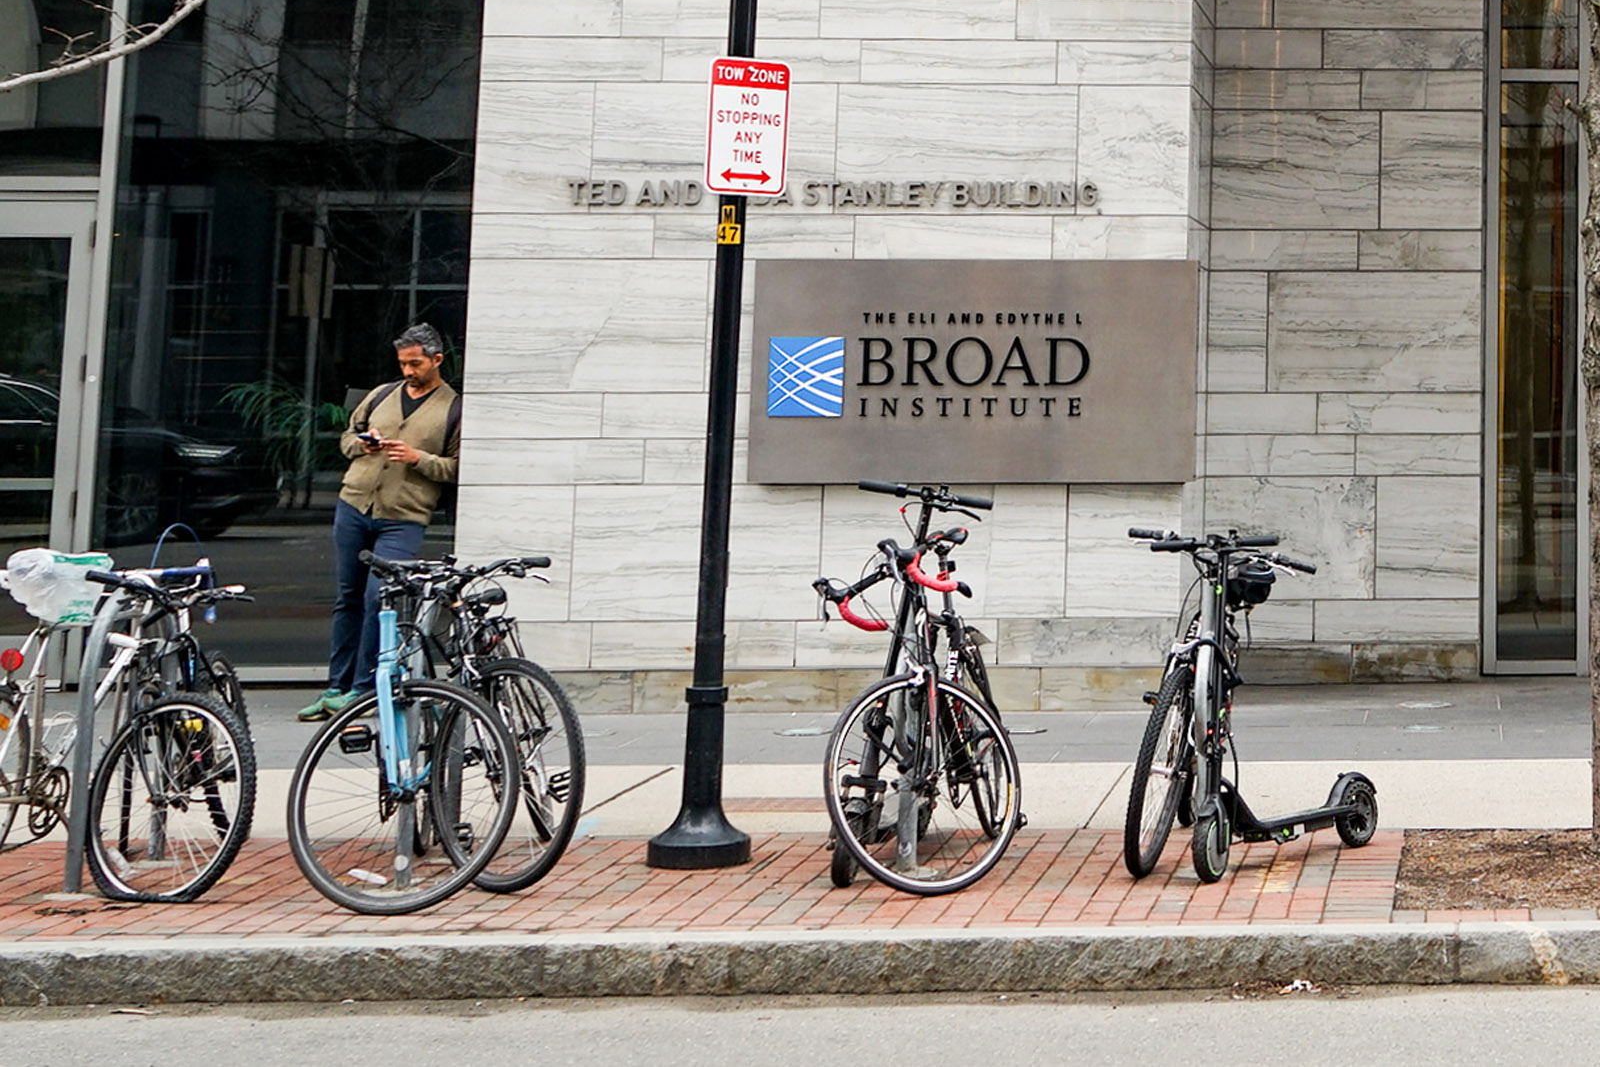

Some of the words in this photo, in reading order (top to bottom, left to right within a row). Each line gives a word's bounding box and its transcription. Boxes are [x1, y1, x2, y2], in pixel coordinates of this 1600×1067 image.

[717, 66, 745, 81] TOW
[749, 68, 786, 84] ZONE
[740, 93, 760, 106] NO
[716, 109, 781, 127] STOPPING
[734, 131, 763, 144] ANY
[732, 149, 763, 164] TIME
[568, 180, 627, 206] TED
[635, 180, 703, 206] AND
[801, 181, 944, 207] STANLEY
[951, 181, 1099, 207] BUILDING
[723, 207, 734, 224] M
[718, 226, 739, 242] 47
[863, 312, 896, 325] THE
[907, 312, 936, 325] ELI
[947, 312, 984, 325] AND
[995, 312, 1066, 325] EDYTHE
[1075, 312, 1083, 325] L
[856, 335, 1090, 387] BROAD
[858, 397, 1082, 418] INSTITUTE
